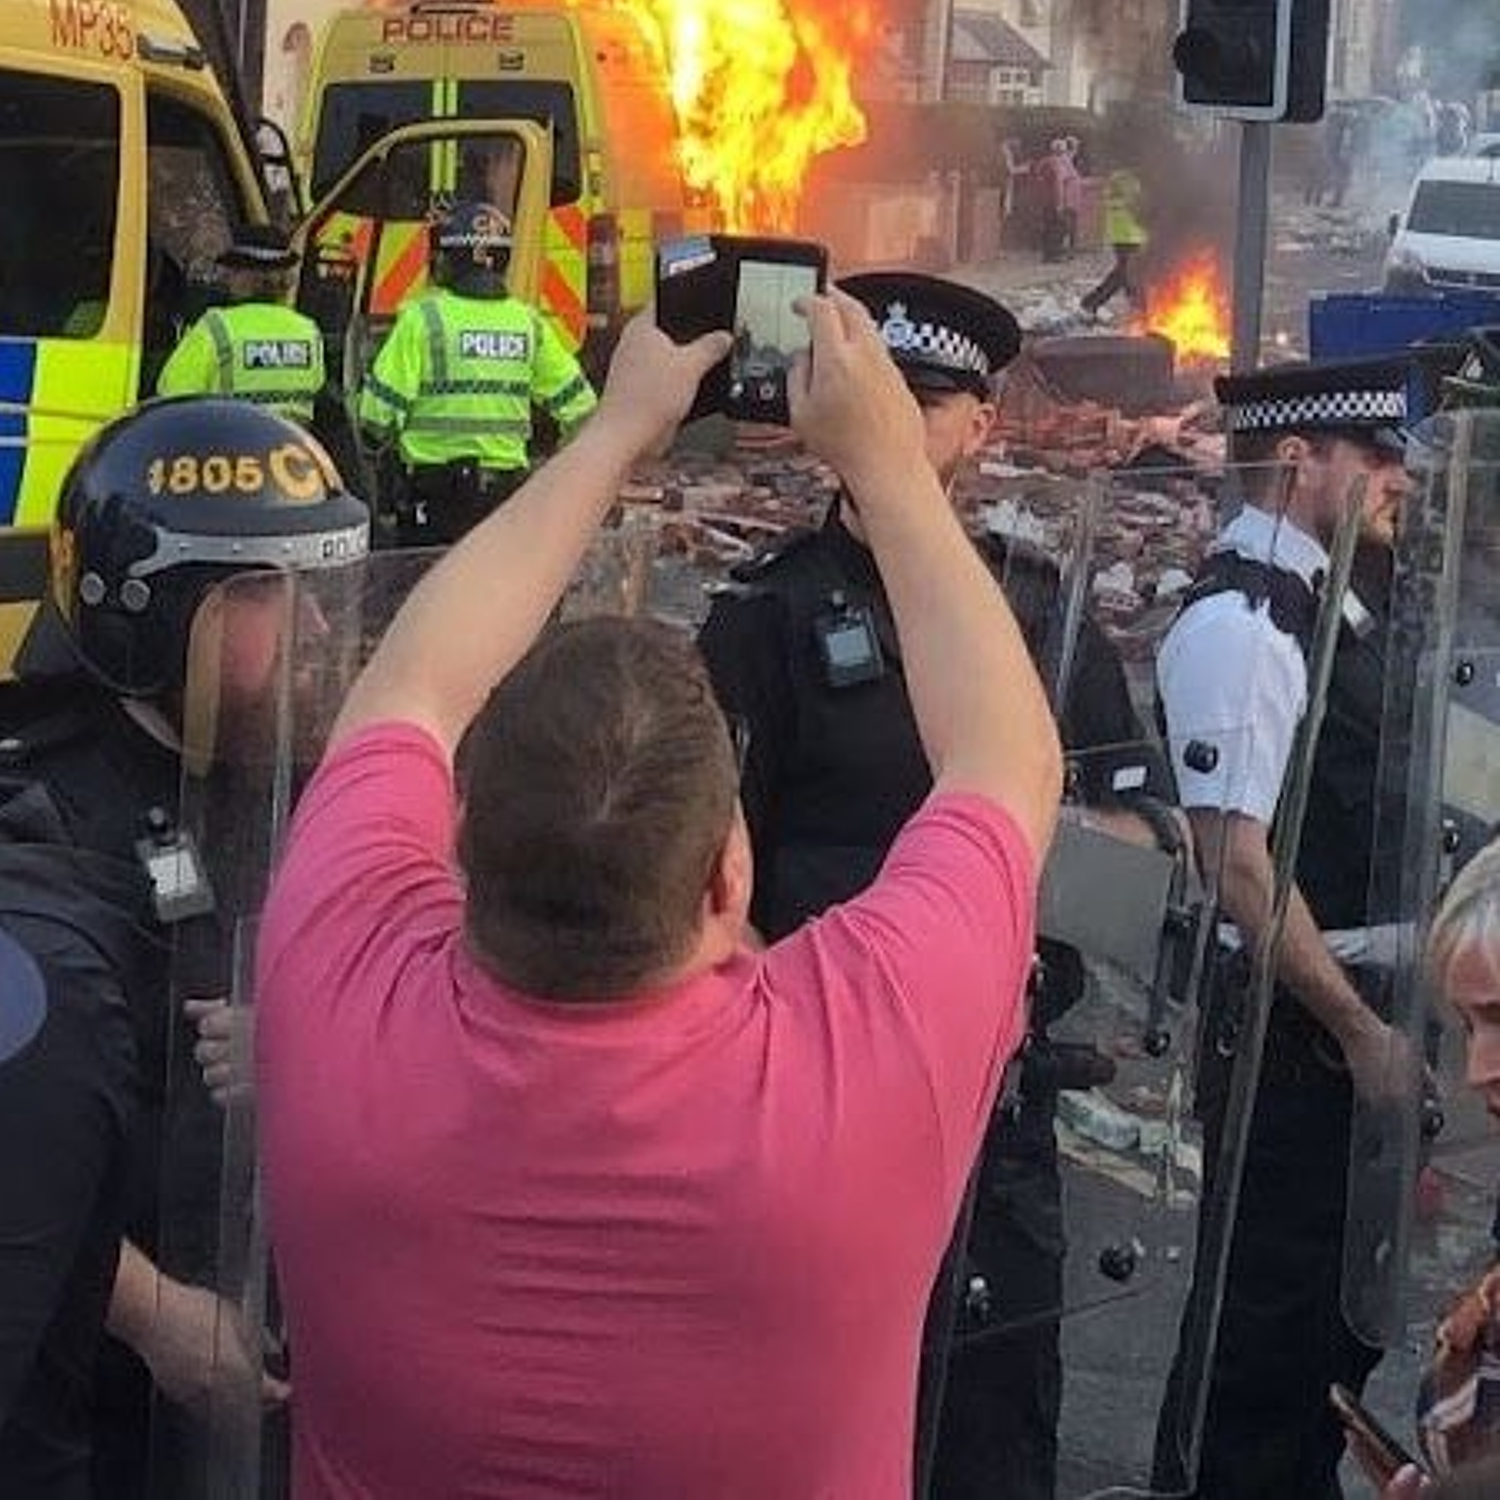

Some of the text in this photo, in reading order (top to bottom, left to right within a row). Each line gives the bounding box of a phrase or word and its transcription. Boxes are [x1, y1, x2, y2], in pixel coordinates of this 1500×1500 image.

[382, 15, 514, 44] POLICE
[244, 340, 309, 368] POLICE
[462, 331, 526, 358] POLICE
